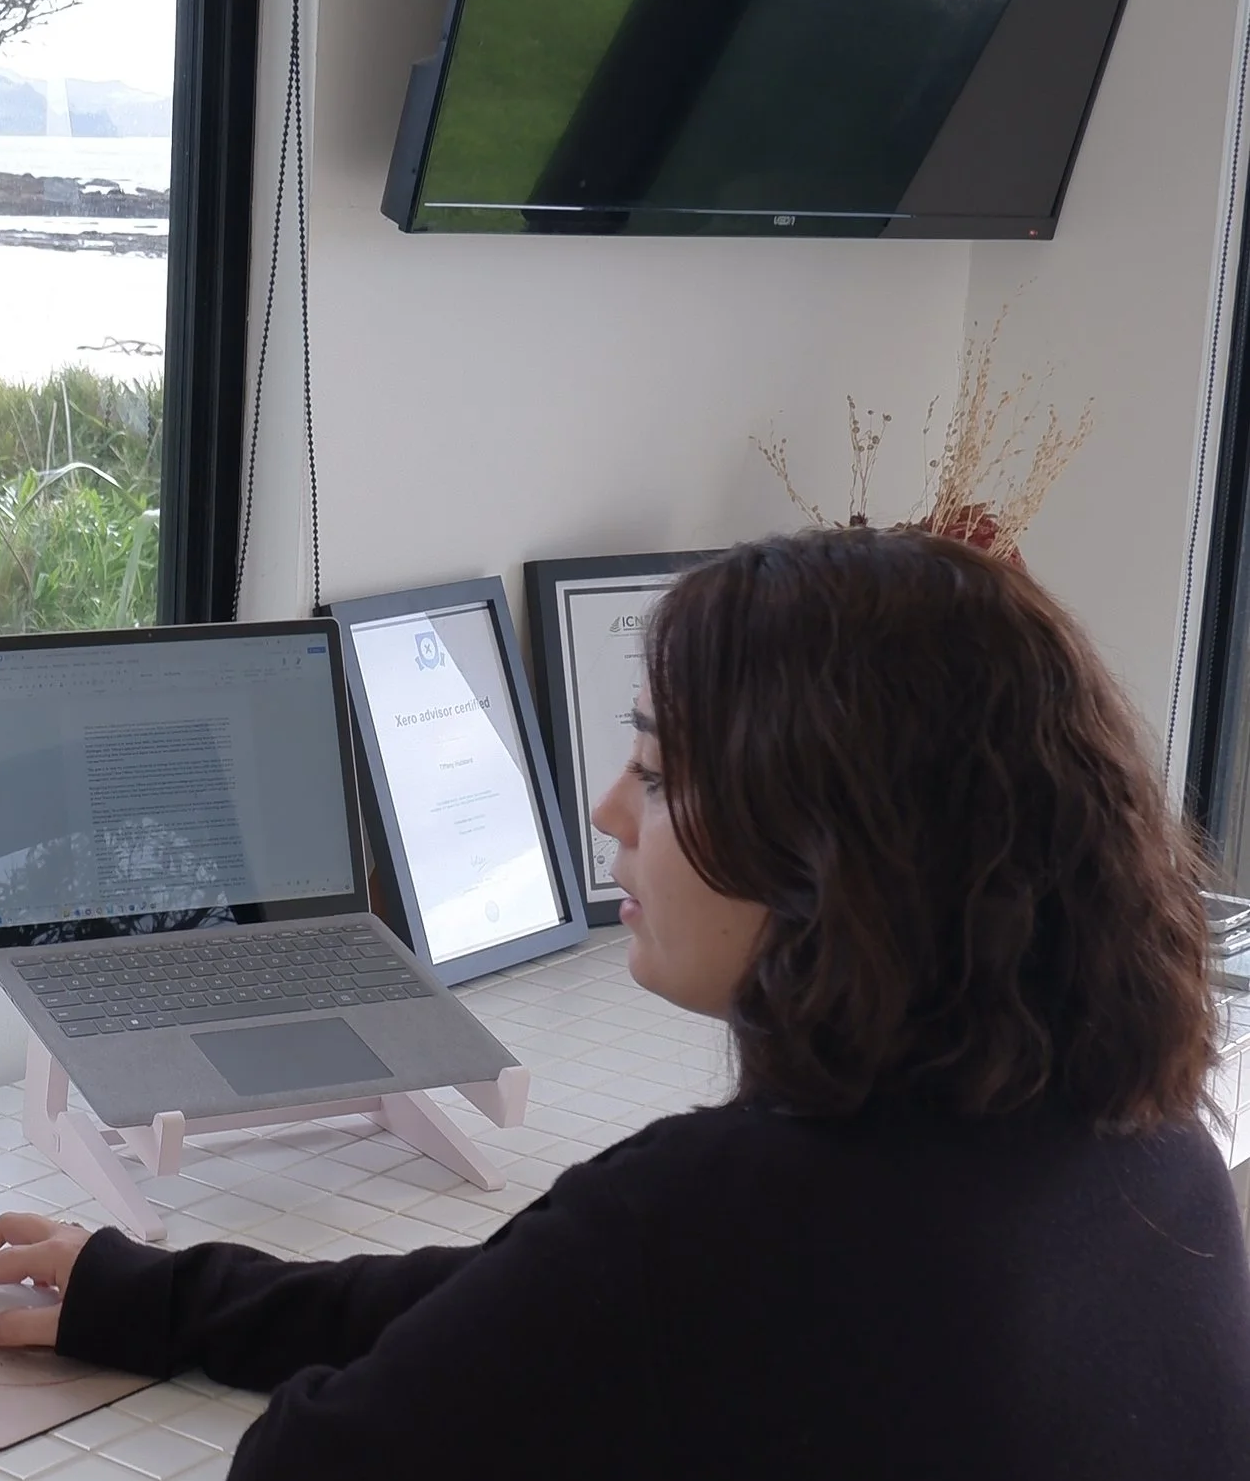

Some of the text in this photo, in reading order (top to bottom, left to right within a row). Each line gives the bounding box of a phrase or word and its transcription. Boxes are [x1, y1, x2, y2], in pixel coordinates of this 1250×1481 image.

[394, 696, 491, 727] Xero advisor certified
